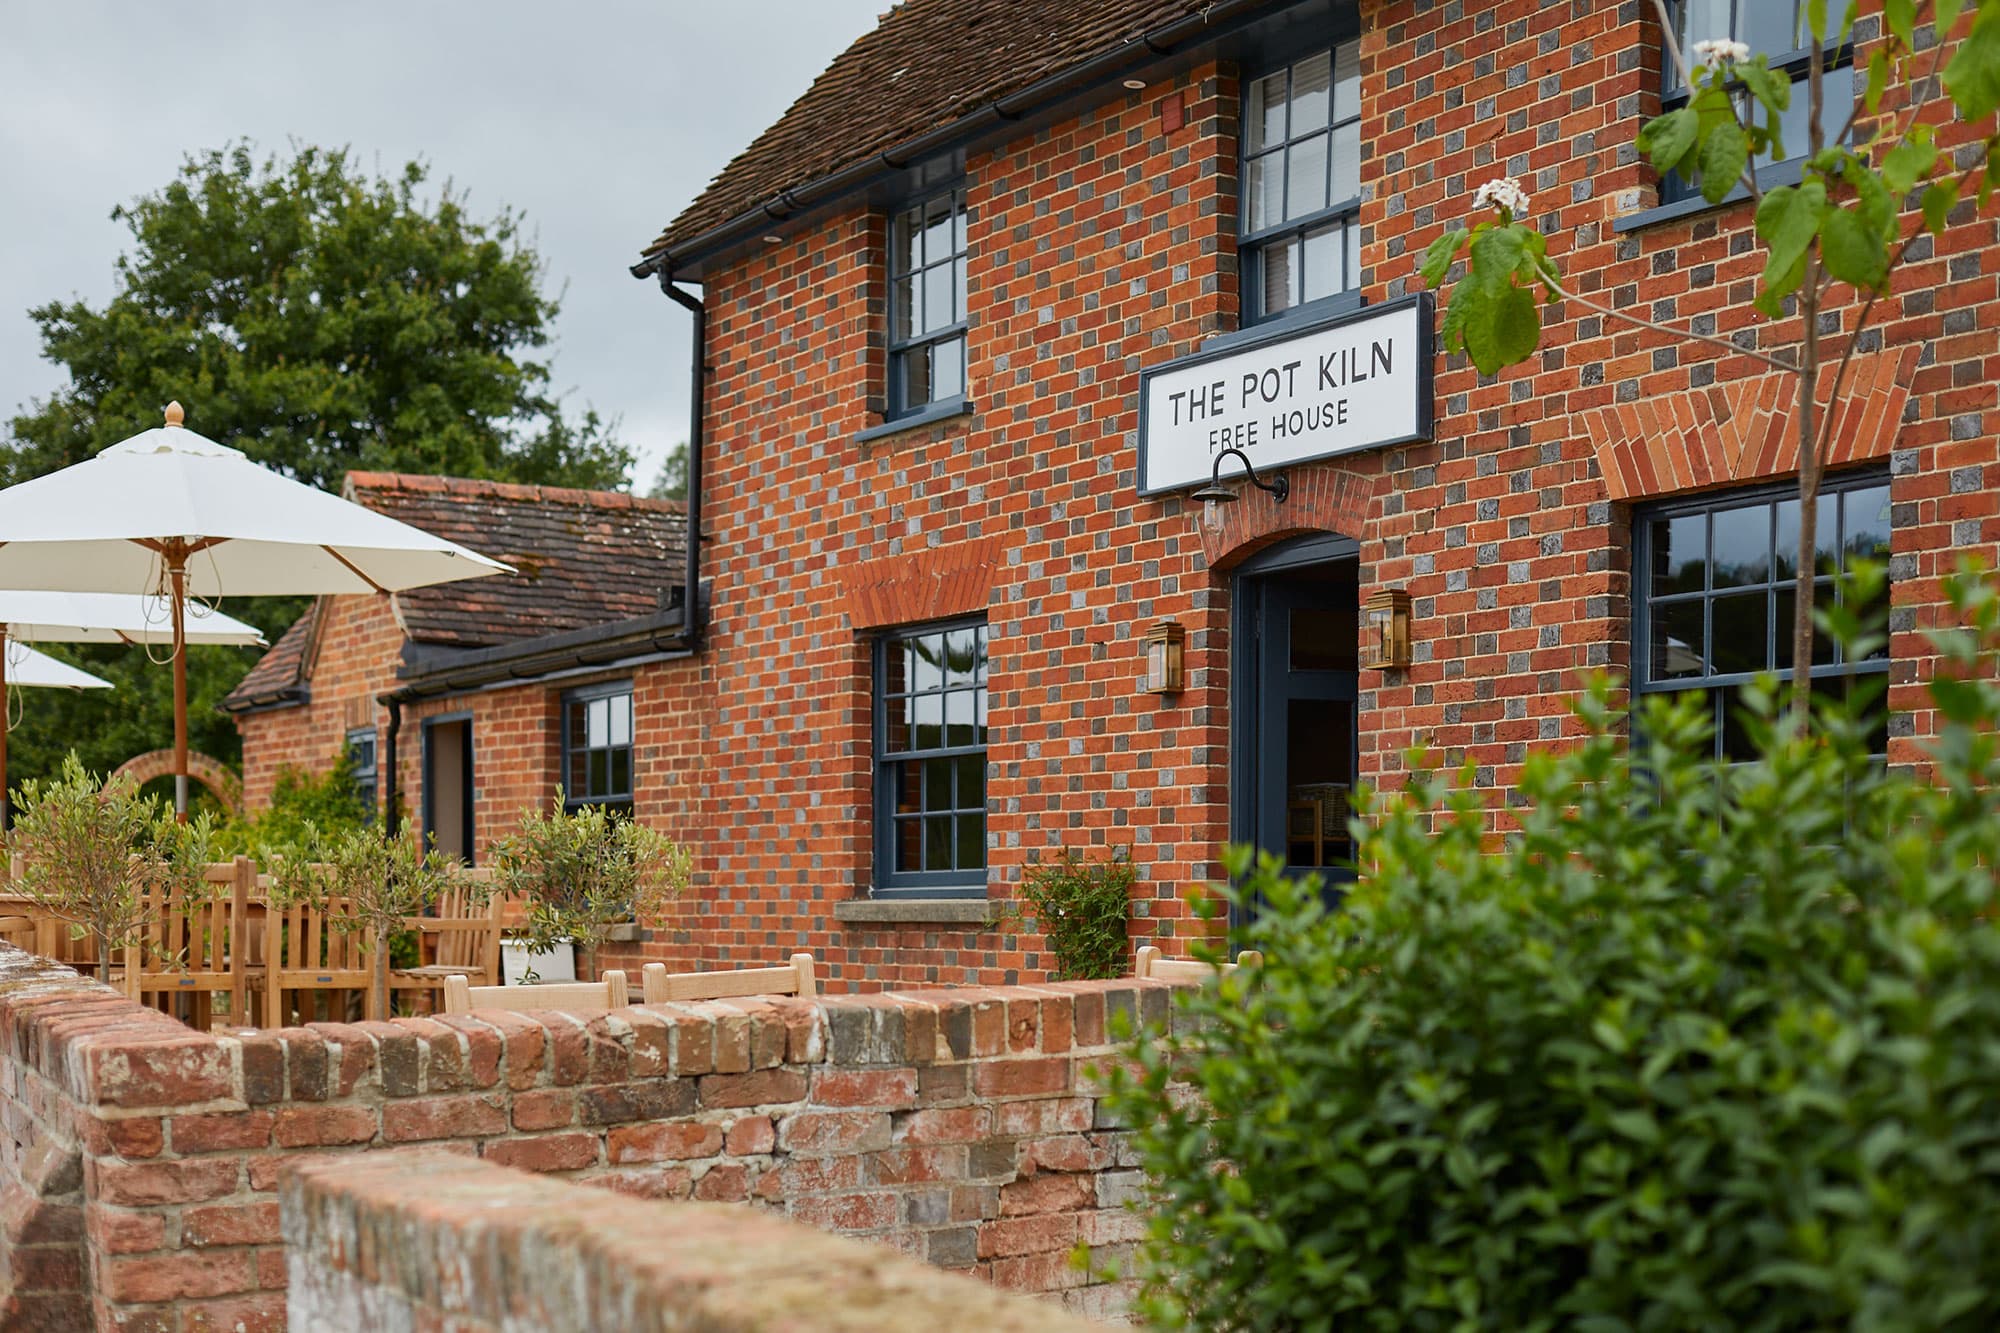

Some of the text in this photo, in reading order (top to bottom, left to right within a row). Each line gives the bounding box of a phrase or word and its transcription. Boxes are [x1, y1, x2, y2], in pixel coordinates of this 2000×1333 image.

[1169, 338, 1393, 425] THE POT KILN
[1209, 399, 1348, 454] FREE HOUSE
